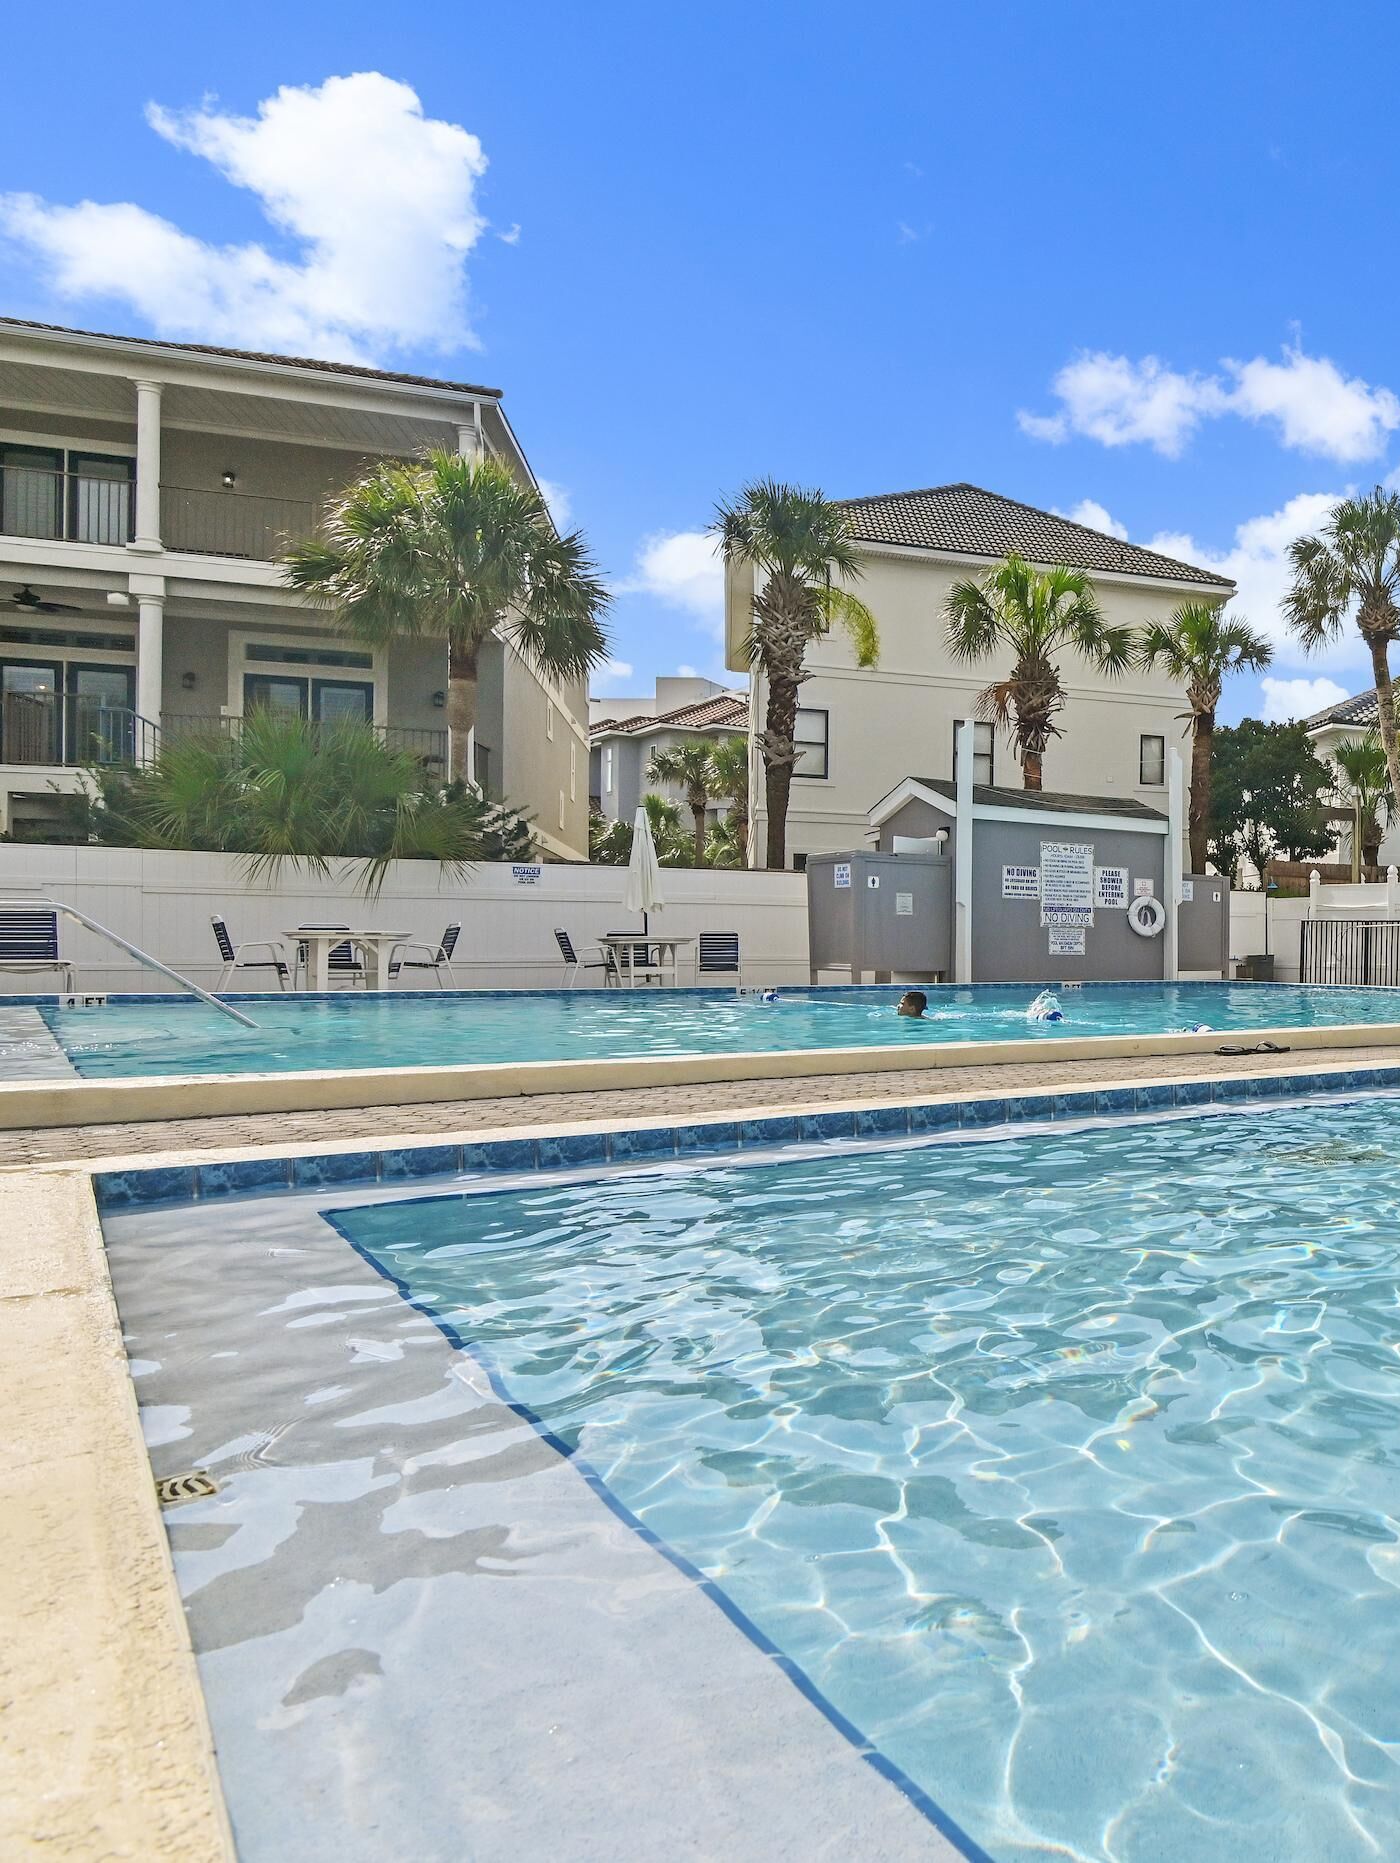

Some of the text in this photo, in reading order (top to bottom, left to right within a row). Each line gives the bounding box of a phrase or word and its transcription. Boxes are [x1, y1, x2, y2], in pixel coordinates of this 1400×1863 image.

[1042, 844, 1093, 855] POOL RULES
[1006, 868, 1015, 876] NO
[1016, 868, 1037, 877] DIVING
[1045, 912, 1090, 923] NO DIVING
[85, 997, 105, 1006] FT
